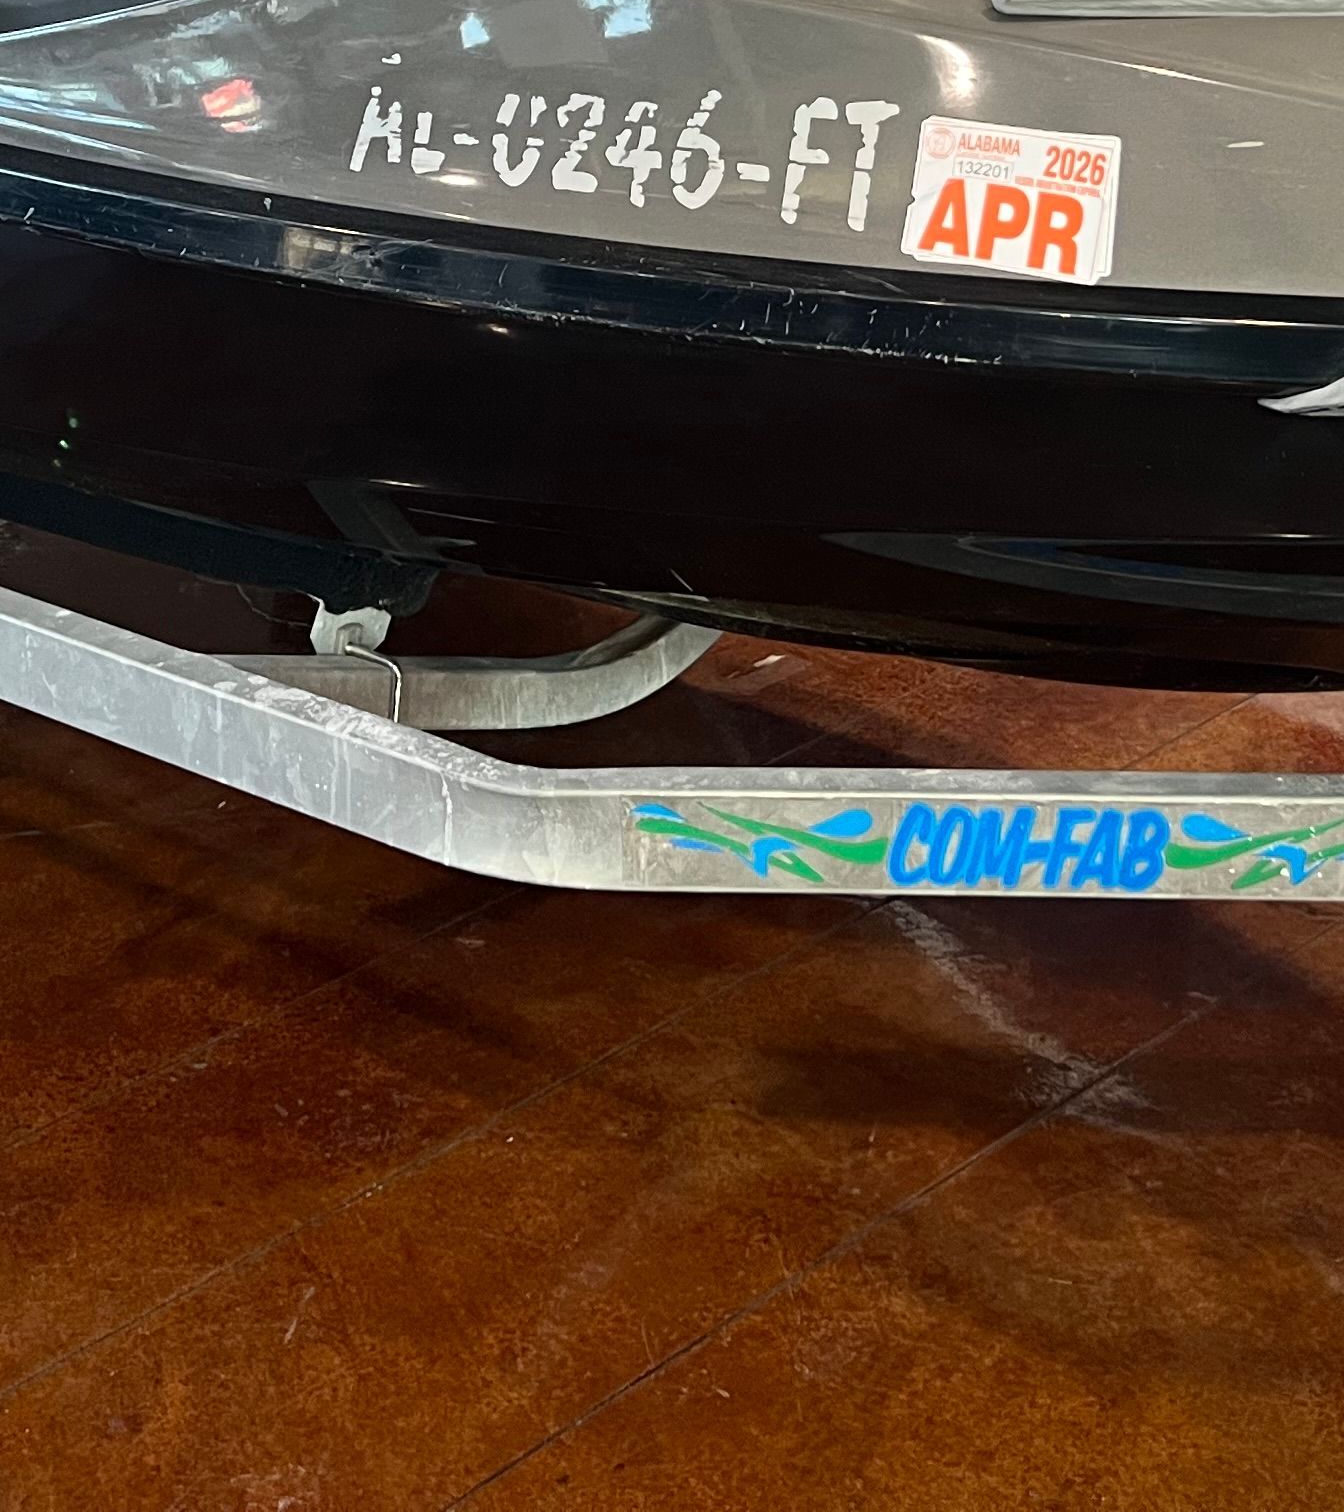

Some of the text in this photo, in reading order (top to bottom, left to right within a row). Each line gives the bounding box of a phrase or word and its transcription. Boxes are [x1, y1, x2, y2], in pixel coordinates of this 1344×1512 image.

[958, 132, 1021, 156] ALABAMA
[957, 160, 1010, 180] 132201
[1043, 145, 1106, 186] 2026
[917, 178, 1084, 276] APR
[885, 801, 1174, 892] COM-FAB
